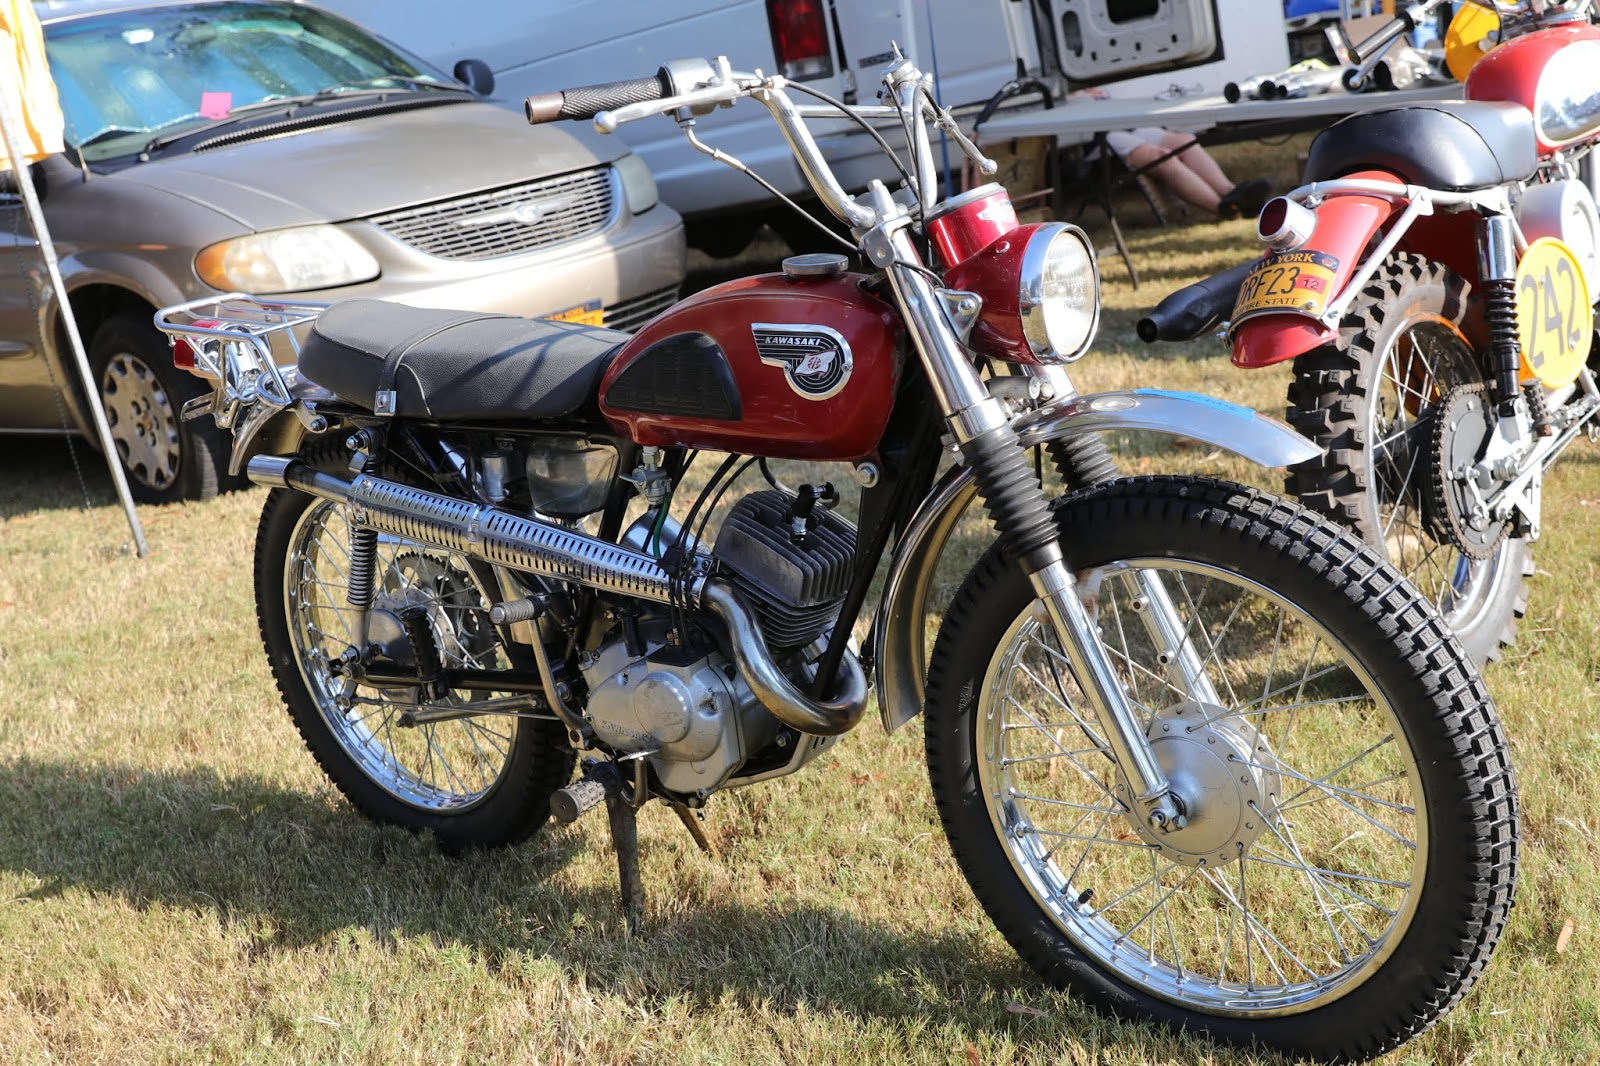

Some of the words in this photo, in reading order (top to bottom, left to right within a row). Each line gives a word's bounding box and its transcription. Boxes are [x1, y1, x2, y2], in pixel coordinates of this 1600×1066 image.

[1277, 252, 1316, 263] YORK
[1303, 279, 1319, 290] 12
[1264, 297, 1298, 306] STATE
[1521, 257, 1581, 369] 242
[764, 336, 821, 347] KAWASAKI
